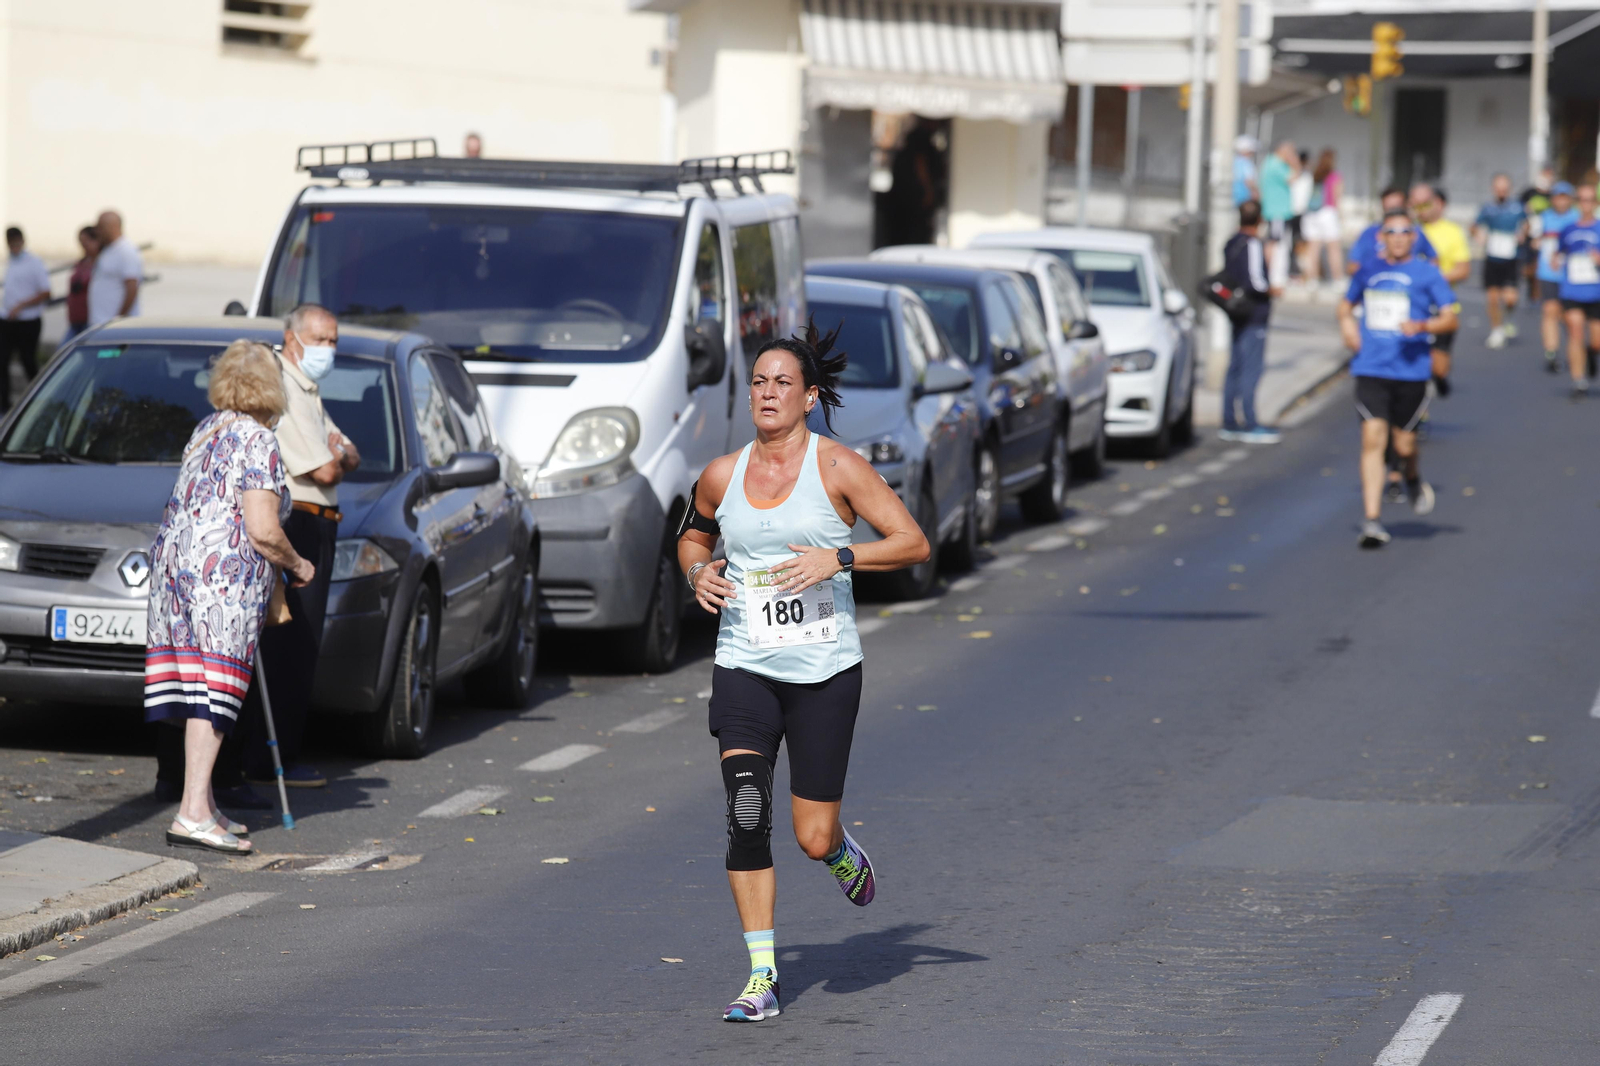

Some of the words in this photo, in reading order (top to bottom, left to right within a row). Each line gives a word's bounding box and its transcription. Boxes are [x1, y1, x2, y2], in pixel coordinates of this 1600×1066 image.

[750, 575, 758, 586] 34
[74, 613, 134, 639] 9244
[762, 598, 804, 627] 180
[849, 866, 869, 899] BROOKS
